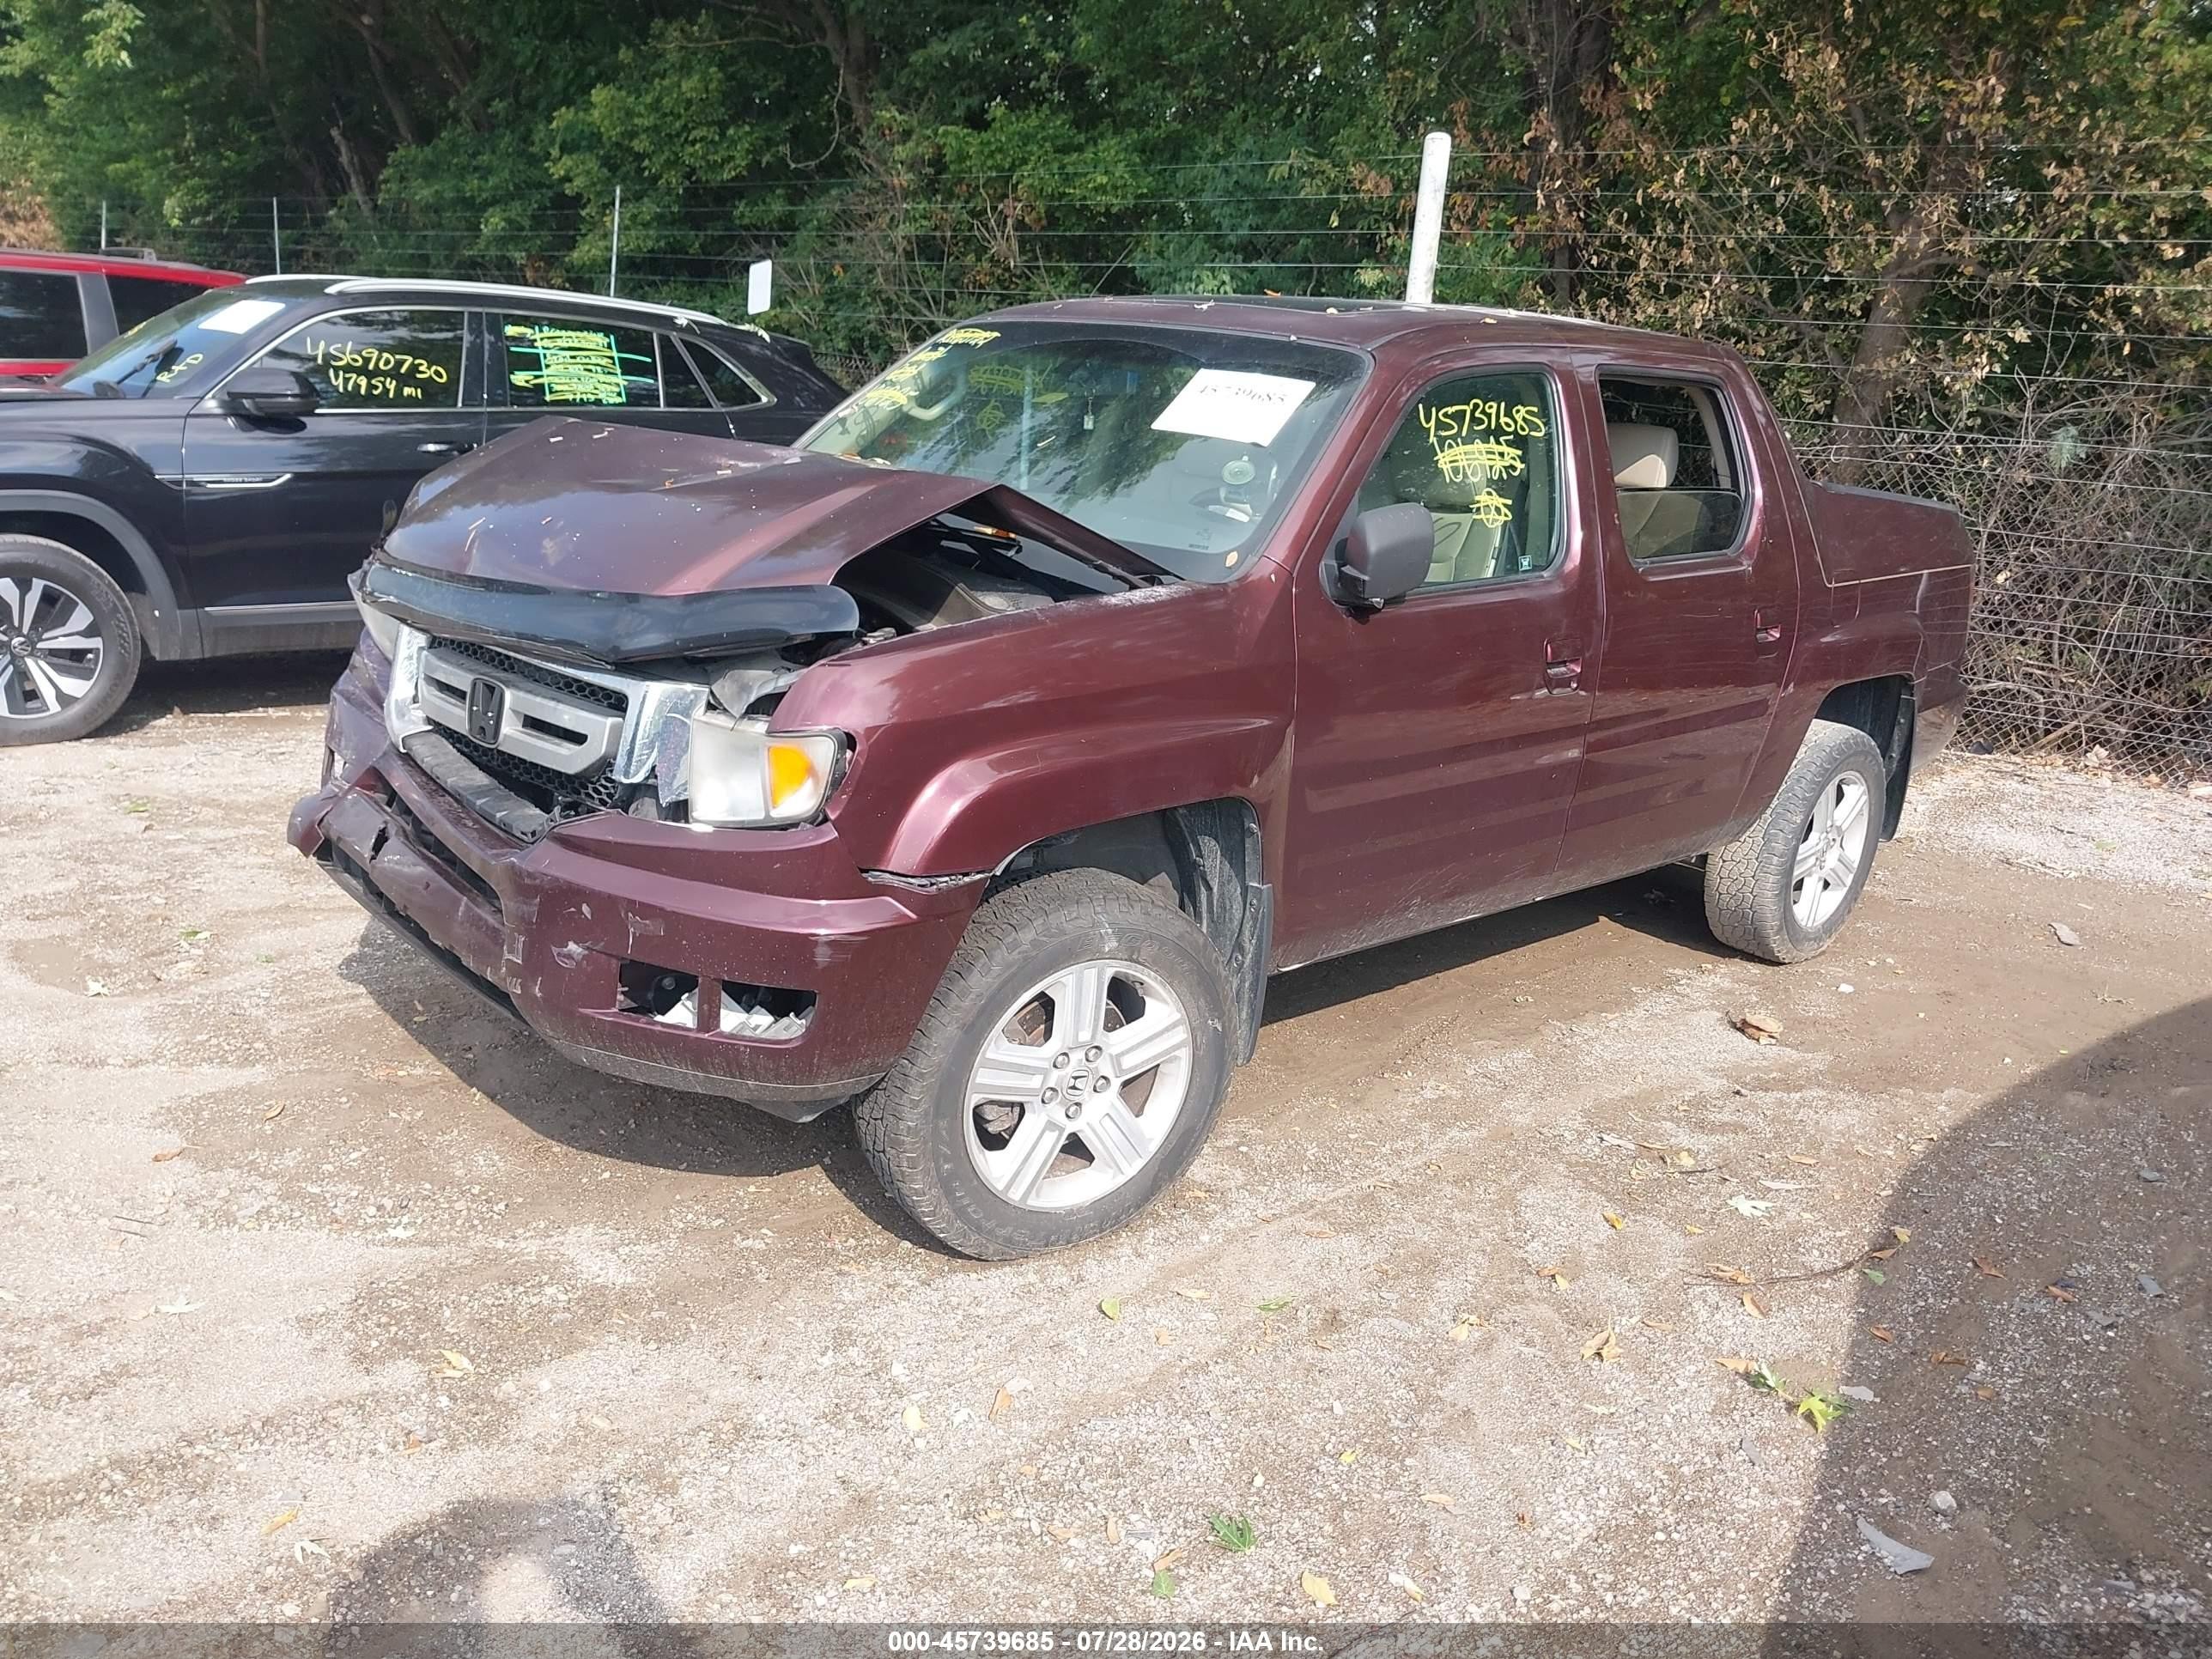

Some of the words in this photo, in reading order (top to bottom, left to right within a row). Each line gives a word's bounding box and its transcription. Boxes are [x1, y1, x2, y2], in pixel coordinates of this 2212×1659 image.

[306, 337, 447, 383] 45690730
[328, 368, 397, 399] 47954
[1419, 398, 1547, 443] 45739685
